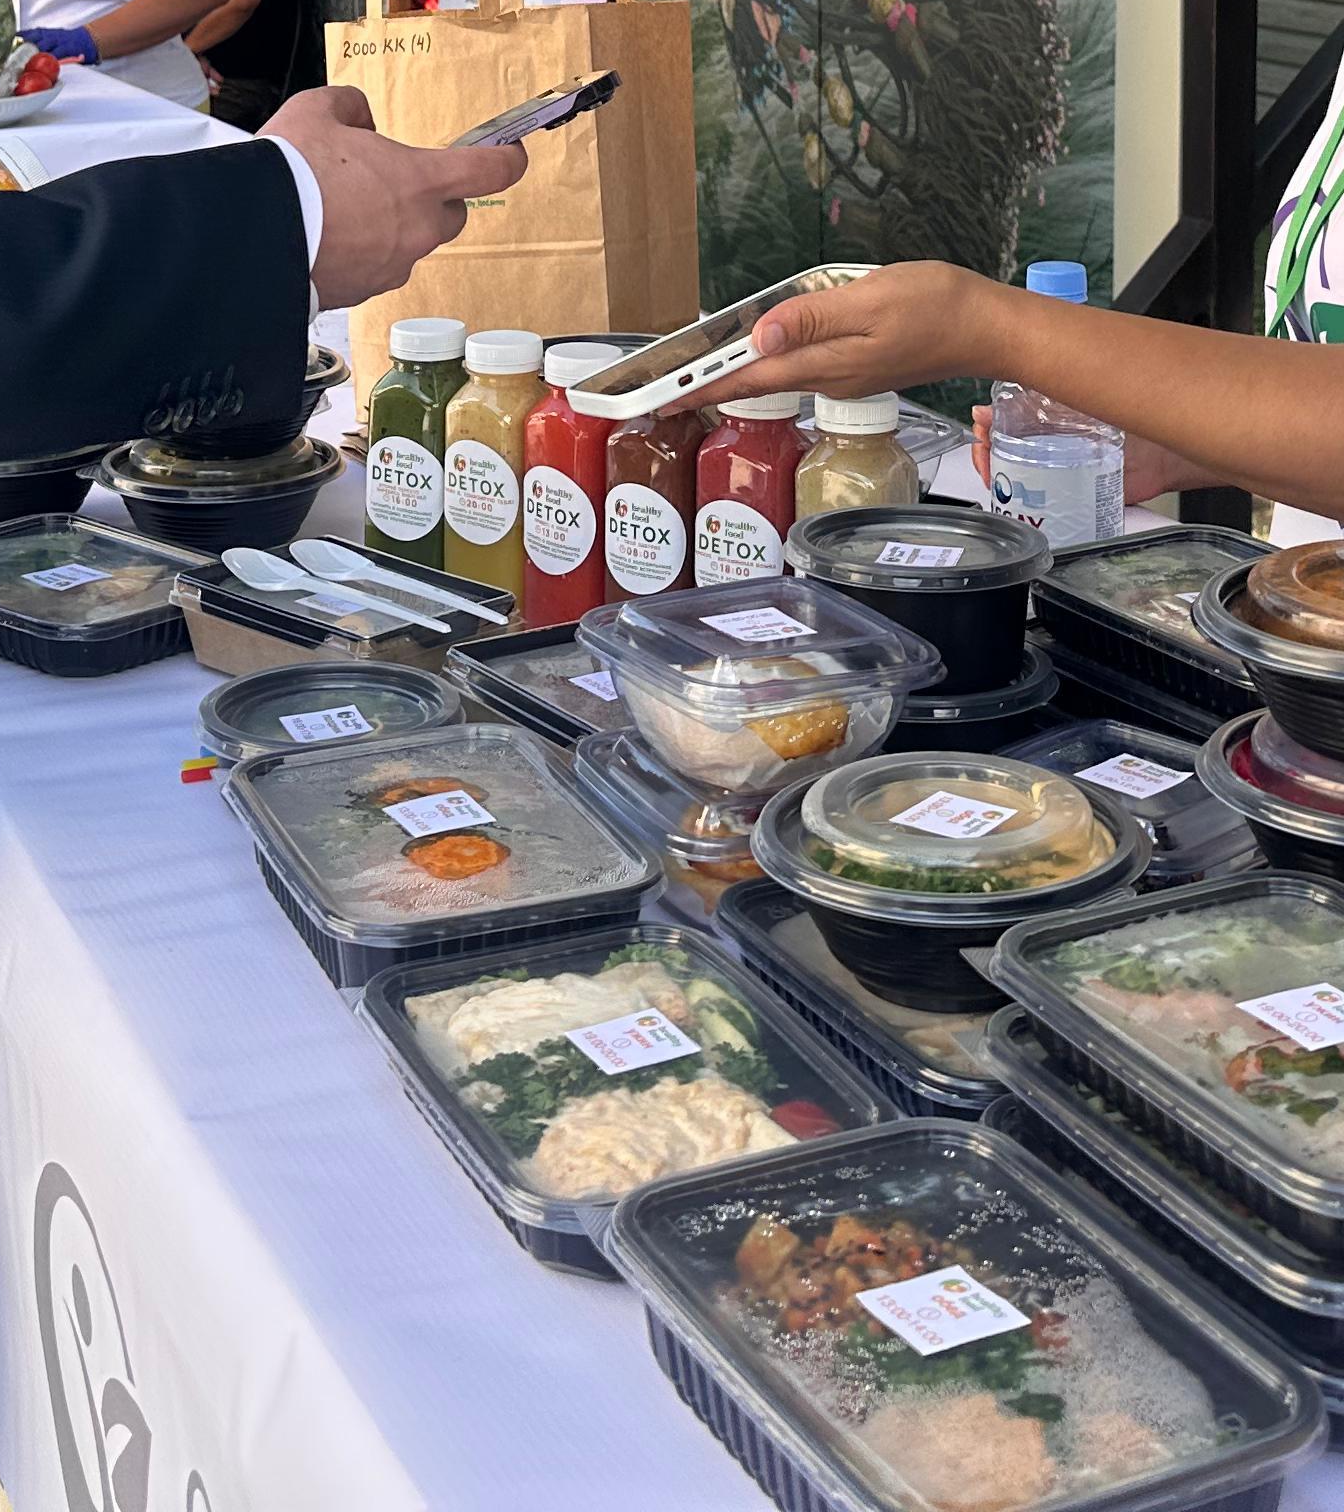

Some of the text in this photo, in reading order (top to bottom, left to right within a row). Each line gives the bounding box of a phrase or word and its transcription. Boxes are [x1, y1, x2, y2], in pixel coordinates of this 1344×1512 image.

[343, 40, 377, 58] 2000
[411, 32, 431, 55] (4)
[372, 464, 433, 491] DETOX
[448, 471, 505, 498] DETOX
[526, 497, 581, 529] DETOX
[609, 516, 671, 546] DETOX
[698, 532, 767, 562] DETOX
[877, 1294, 944, 1346] 13:00-14:00
[931, 1295, 968, 1319] обед
